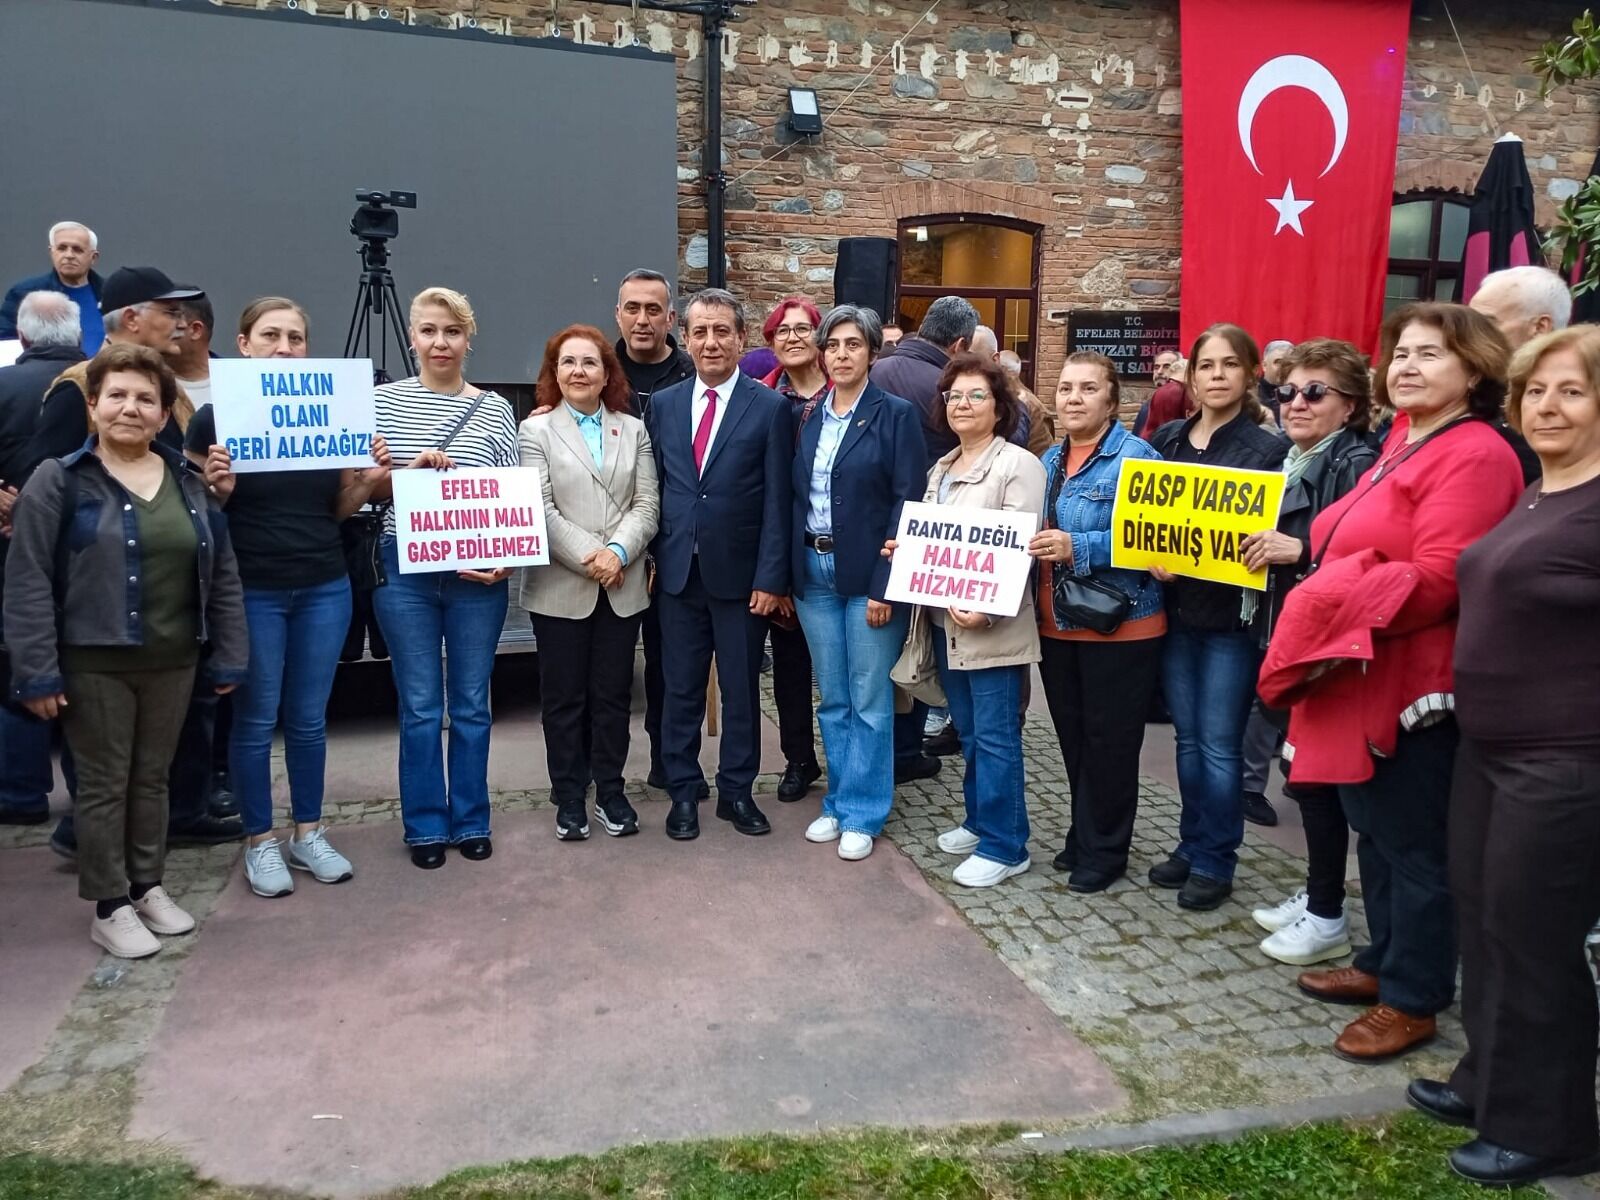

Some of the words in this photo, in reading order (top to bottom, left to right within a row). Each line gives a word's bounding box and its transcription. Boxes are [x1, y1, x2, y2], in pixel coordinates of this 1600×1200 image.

[1076, 329, 1121, 338] EFELER
[1125, 317, 1144, 326] T.C.
[261, 373, 334, 396] HALKIN
[271, 404, 329, 428] OLANI
[226, 431, 271, 461] GERİ
[276, 428, 372, 459] ALACAĞIZ!
[441, 479, 500, 500] EFELER
[1128, 471, 1186, 507] GASP
[1192, 477, 1266, 517] VARSA
[410, 507, 490, 532] HALKININ
[494, 507, 534, 528] MALI
[407, 540, 452, 563] GASP
[456, 533, 541, 560] EDİLEMEZ!
[906, 519, 963, 542] RANTA
[968, 525, 1025, 551] DEĞİL,
[1123, 513, 1203, 567] DİRENİŞ
[922, 544, 995, 574] HALKA
[909, 569, 999, 603] HİZMET!
